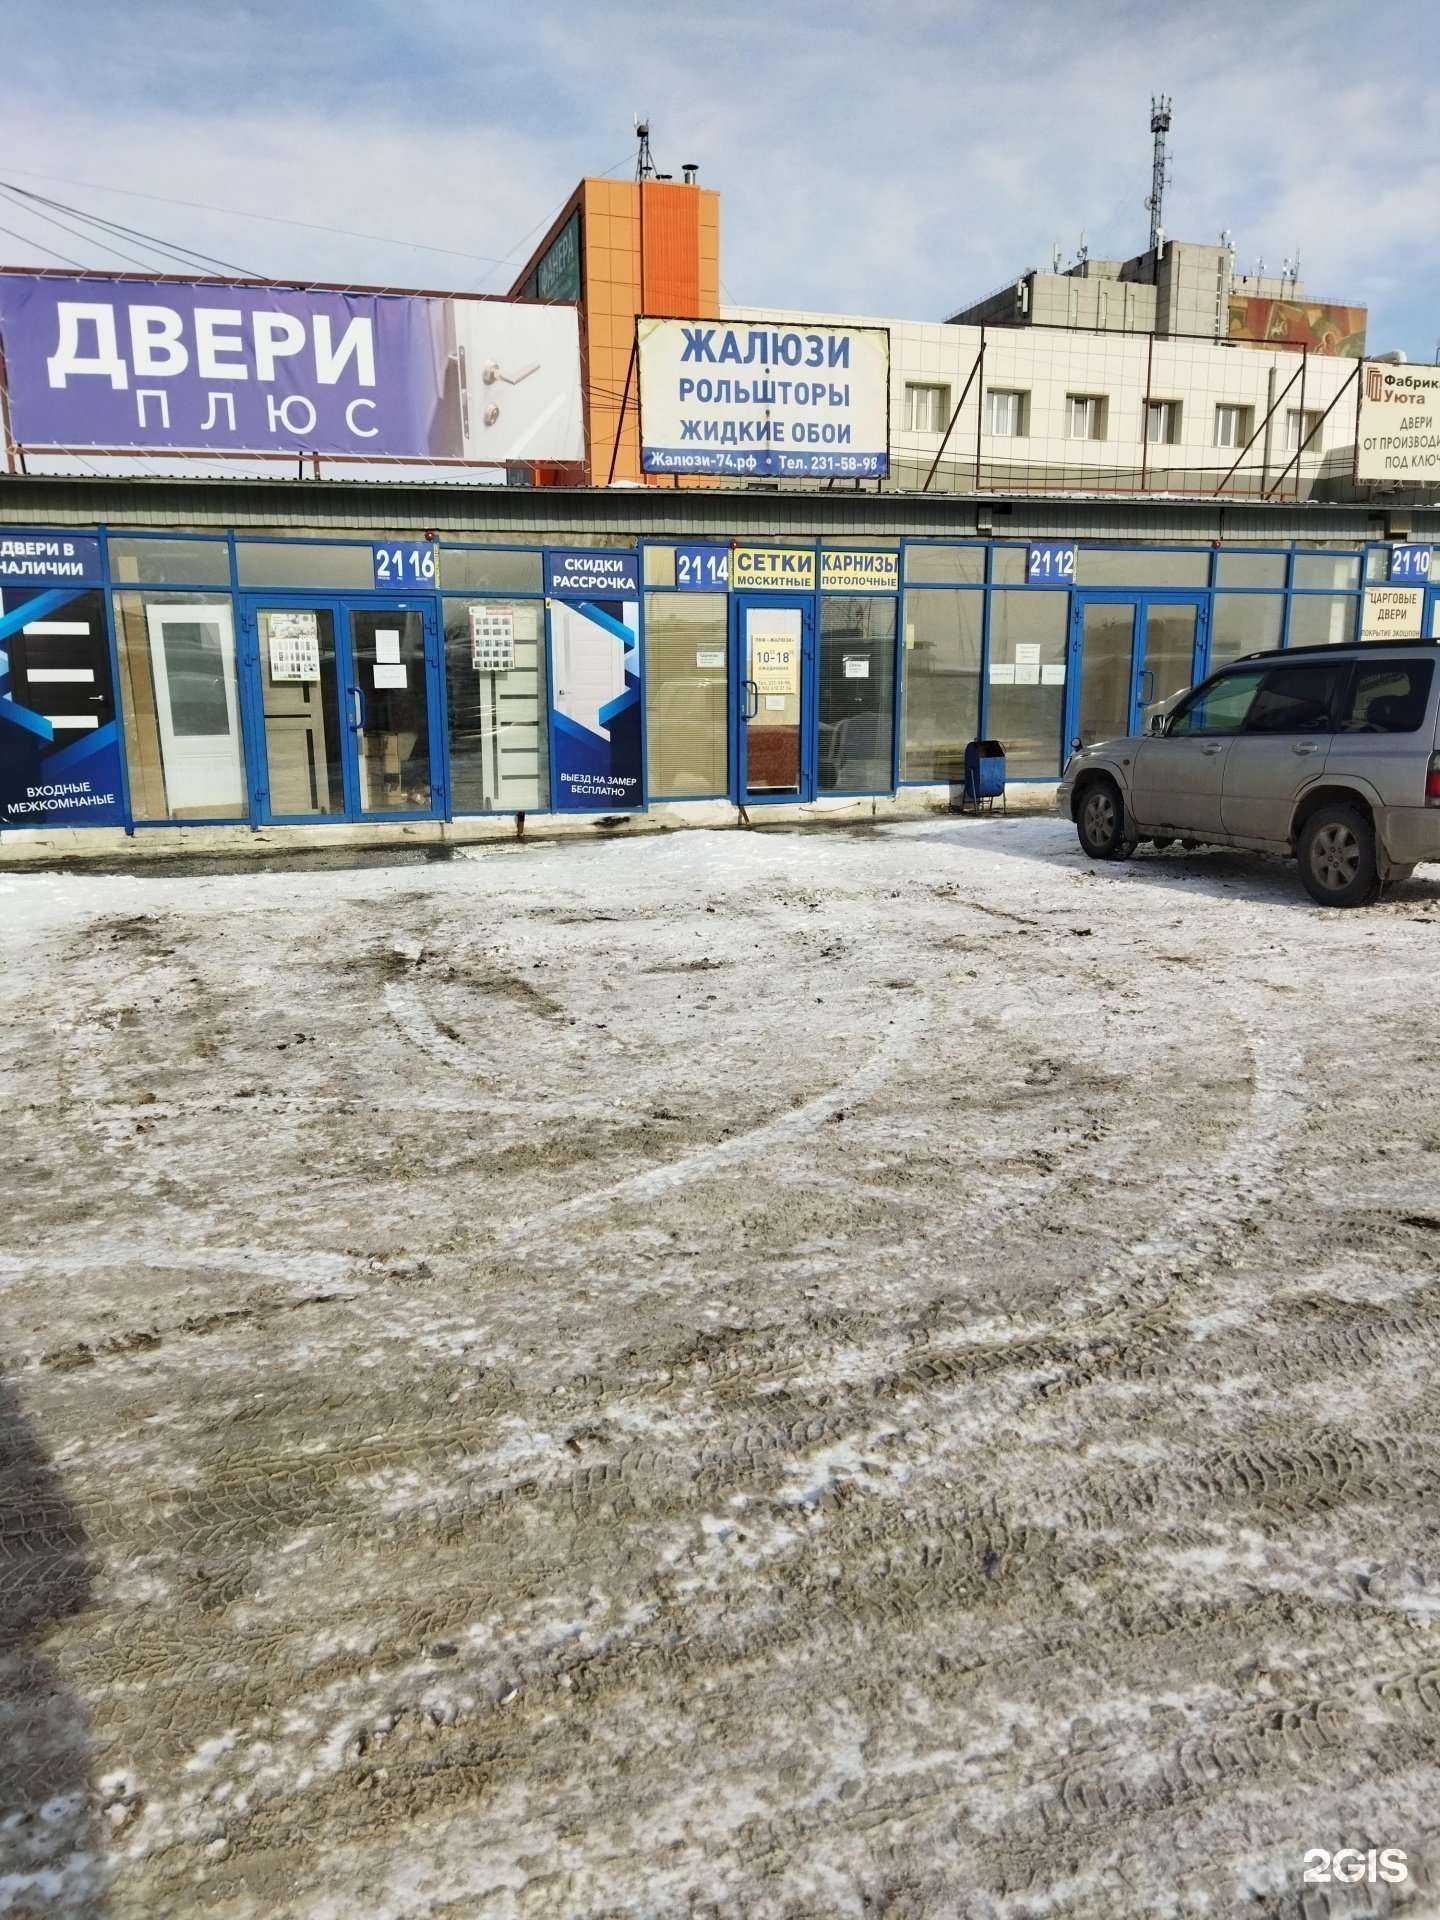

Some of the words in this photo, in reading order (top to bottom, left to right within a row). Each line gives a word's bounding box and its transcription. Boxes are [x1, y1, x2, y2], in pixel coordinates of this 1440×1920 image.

[47, 302, 376, 390] ДВЕРИ
[680, 328, 850, 369] ЖАЛЮЗИ
[1384, 375, 1440, 390] Фабрик
[679, 378, 850, 407] РОЛЬШТОРЫ
[1384, 390, 1425, 405] Уюта
[136, 389, 379, 438] ПЛЮС
[1400, 416, 1433, 431] ДВЕРИ
[680, 419, 785, 445] ЖИДКИЕ
[791, 422, 851, 444] ОБОИ
[1363, 438, 1377, 450] ОТ
[651, 451, 757, 471] Жалюзи-74.рф
[779, 456, 808, 470] Тел.
[811, 456, 878, 471] 231-58-98
[1385, 455, 1408, 469] ПОД
[0, 541, 59, 557] ДВЕРИ
[63, 543, 75, 556] В
[564, 558, 624, 573] СКИДКИ
[737, 552, 812, 573] СЕТКИ
[821, 554, 899, 573] КАРНИЗЫ
[553, 575, 636, 589] РАССРОЧКА
[737, 575, 811, 587] МОСКИТНЫЕ
[822, 576, 897, 587] ПОТОЛОЧНЫЕ
[1370, 593, 1417, 605] ЦАРГОВЫЕ
[1377, 608, 1407, 621] ДВЕРИ
[560, 773, 591, 784] ВЫЕЗД
[592, 776, 606, 784] НА
[607, 776, 637, 786] ЗАМЕР
[26, 781, 92, 798] ВХОДНЫЕ
[571, 785, 625, 797] БЕСПЛАТНО
[7, 793, 115, 814] МЕЖКОМНАНЫЕ
